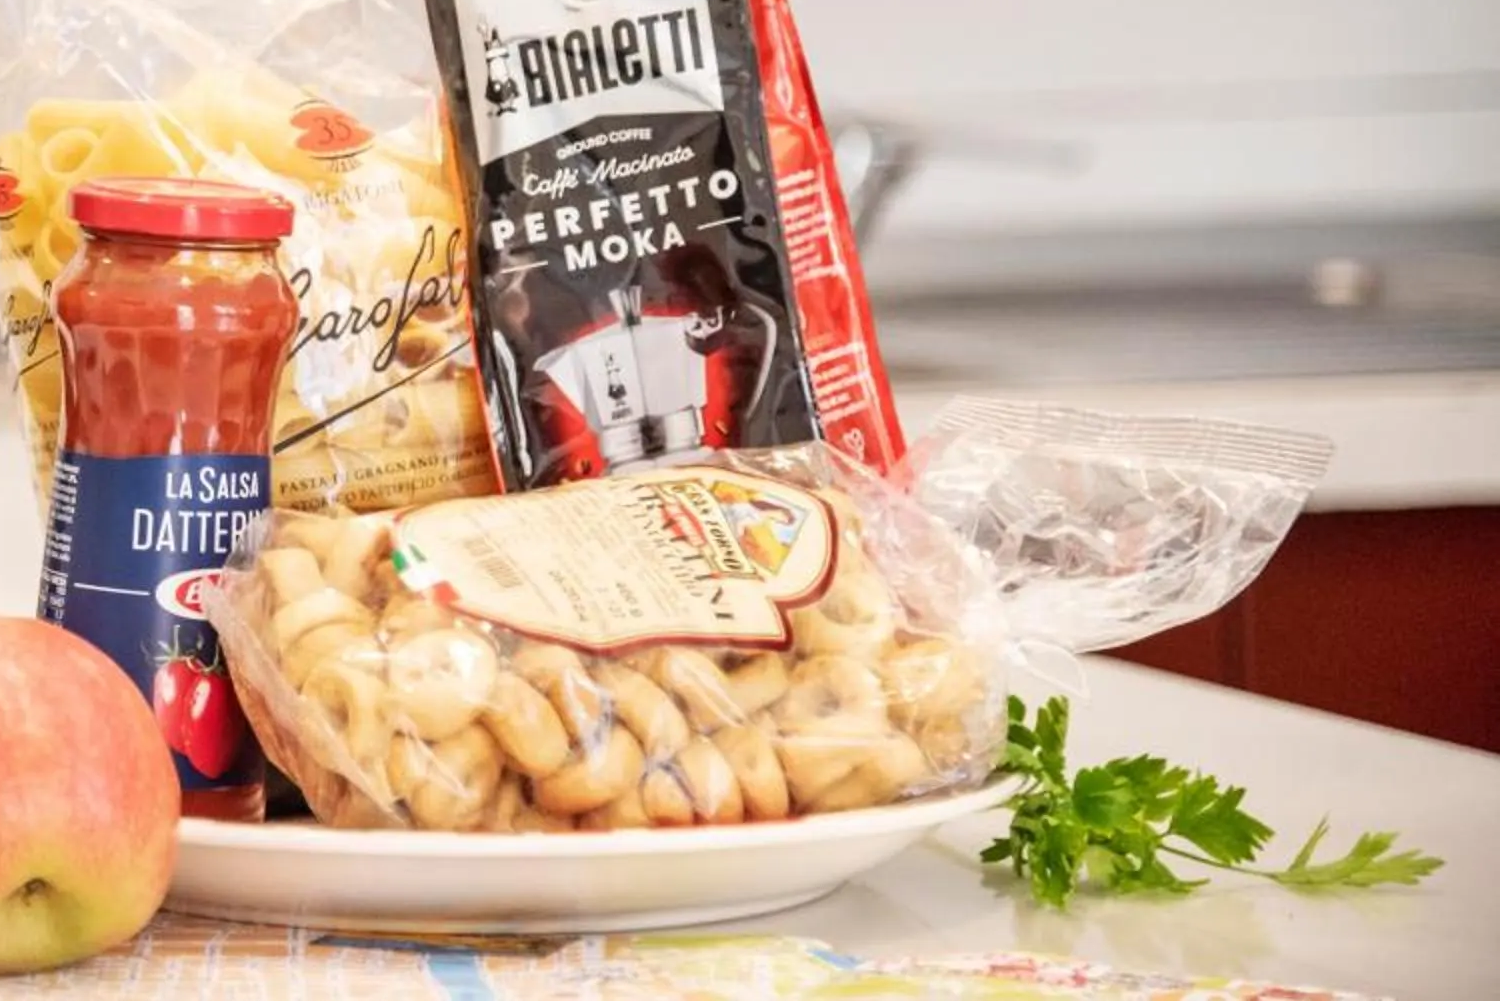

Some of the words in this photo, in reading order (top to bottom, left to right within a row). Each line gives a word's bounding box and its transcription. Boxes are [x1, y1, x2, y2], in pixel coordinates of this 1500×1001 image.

[313, 115, 352, 146] 35
[556, 133, 607, 160] GROUND
[609, 127, 653, 147] COFFEE
[585, 145, 696, 184] Macinato
[490, 169, 738, 251] PERFETTO
[563, 221, 687, 272] MOKA
[165, 471, 193, 500] LA
[198, 465, 260, 504] SALSA
[353, 455, 440, 482] GRAGNANO
